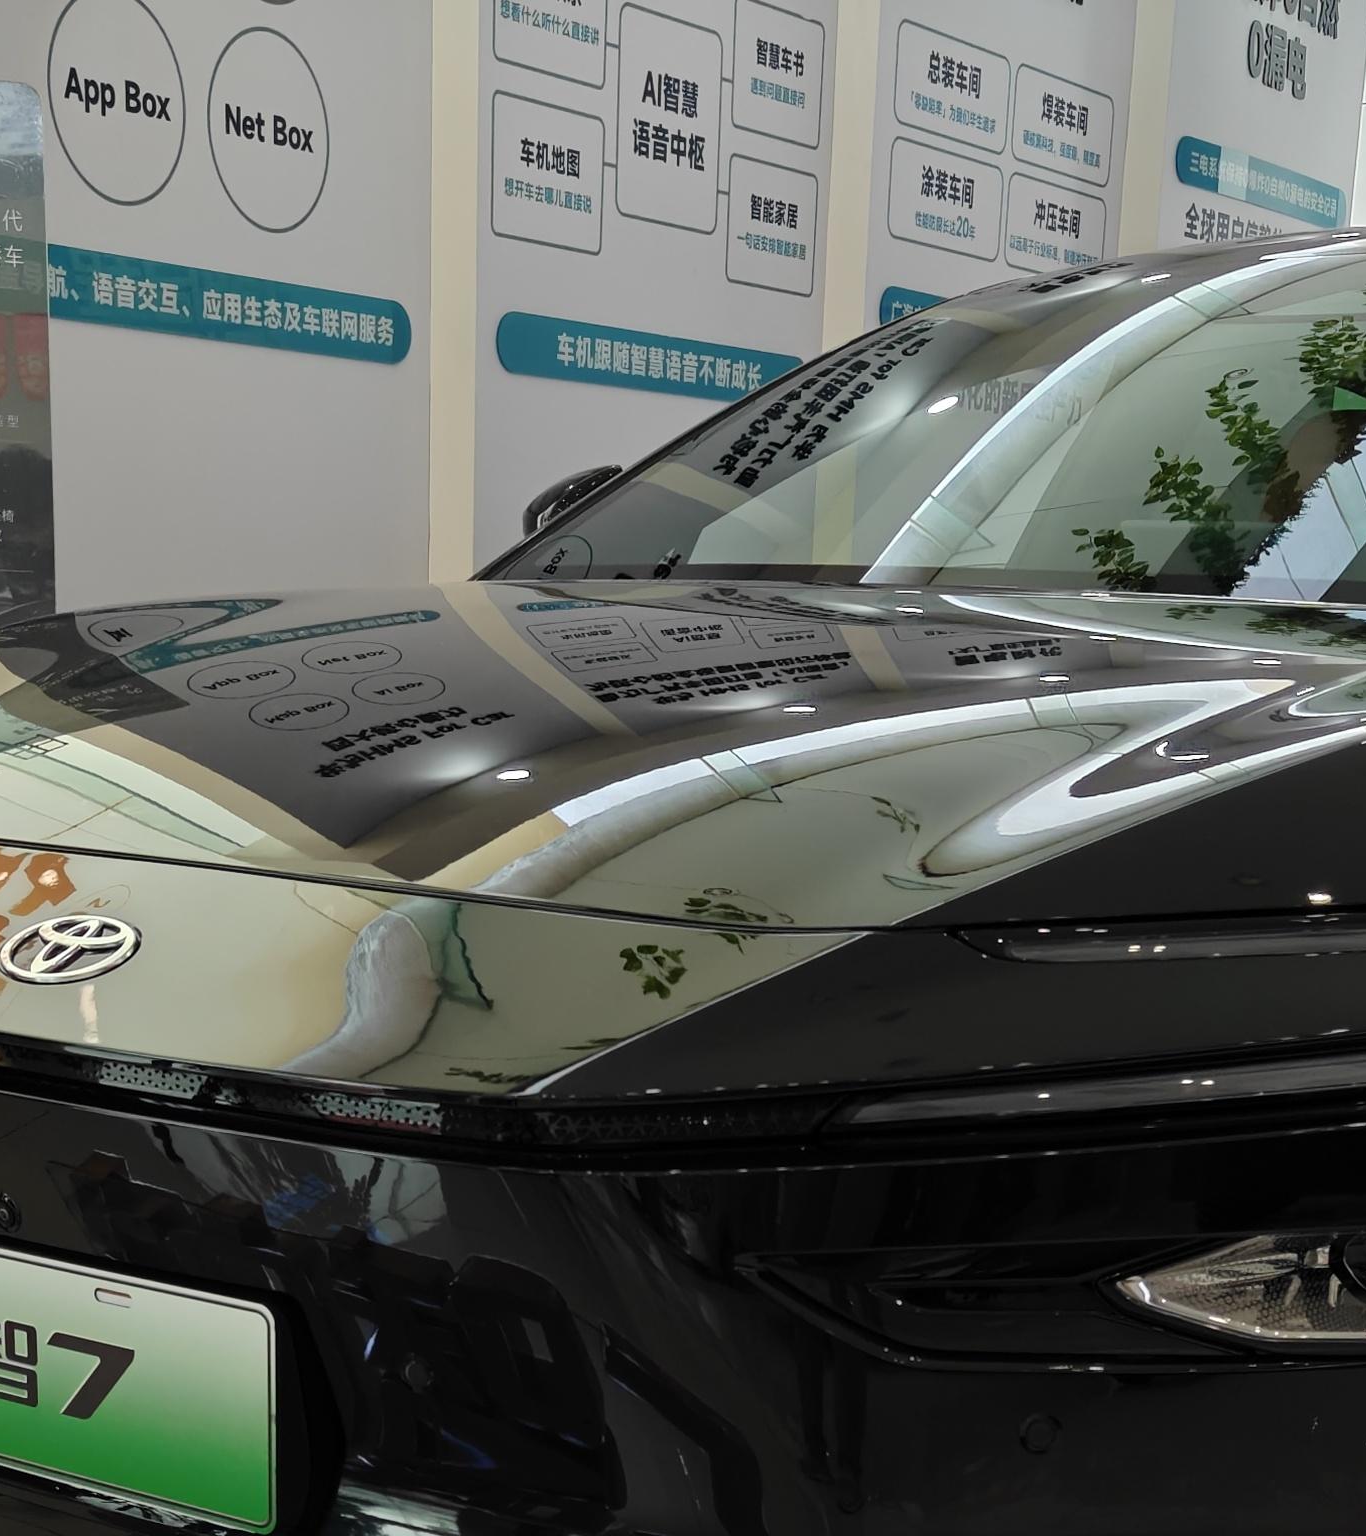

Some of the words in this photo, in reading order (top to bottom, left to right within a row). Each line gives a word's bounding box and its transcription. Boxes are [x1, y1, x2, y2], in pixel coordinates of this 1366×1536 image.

[756, 37, 804, 78] 智慧车书
[927, 50, 982, 99] 总装车间
[64, 67, 116, 116] App
[124, 80, 172, 122] Box
[641, 70, 699, 120] AI智慧
[1041, 91, 1089, 136] 焊装车间
[223, 104, 265, 144] Net
[272, 115, 314, 153] Box
[632, 117, 706, 172] 语音中枢
[520, 137, 581, 179] 车机地图
[921, 165, 975, 209] 涂装车间
[750, 194, 798, 230] 智能家居
[1034, 199, 1081, 239] 冲压车间
[556, 331, 763, 392] 车机跟随智慧语音不断成长
